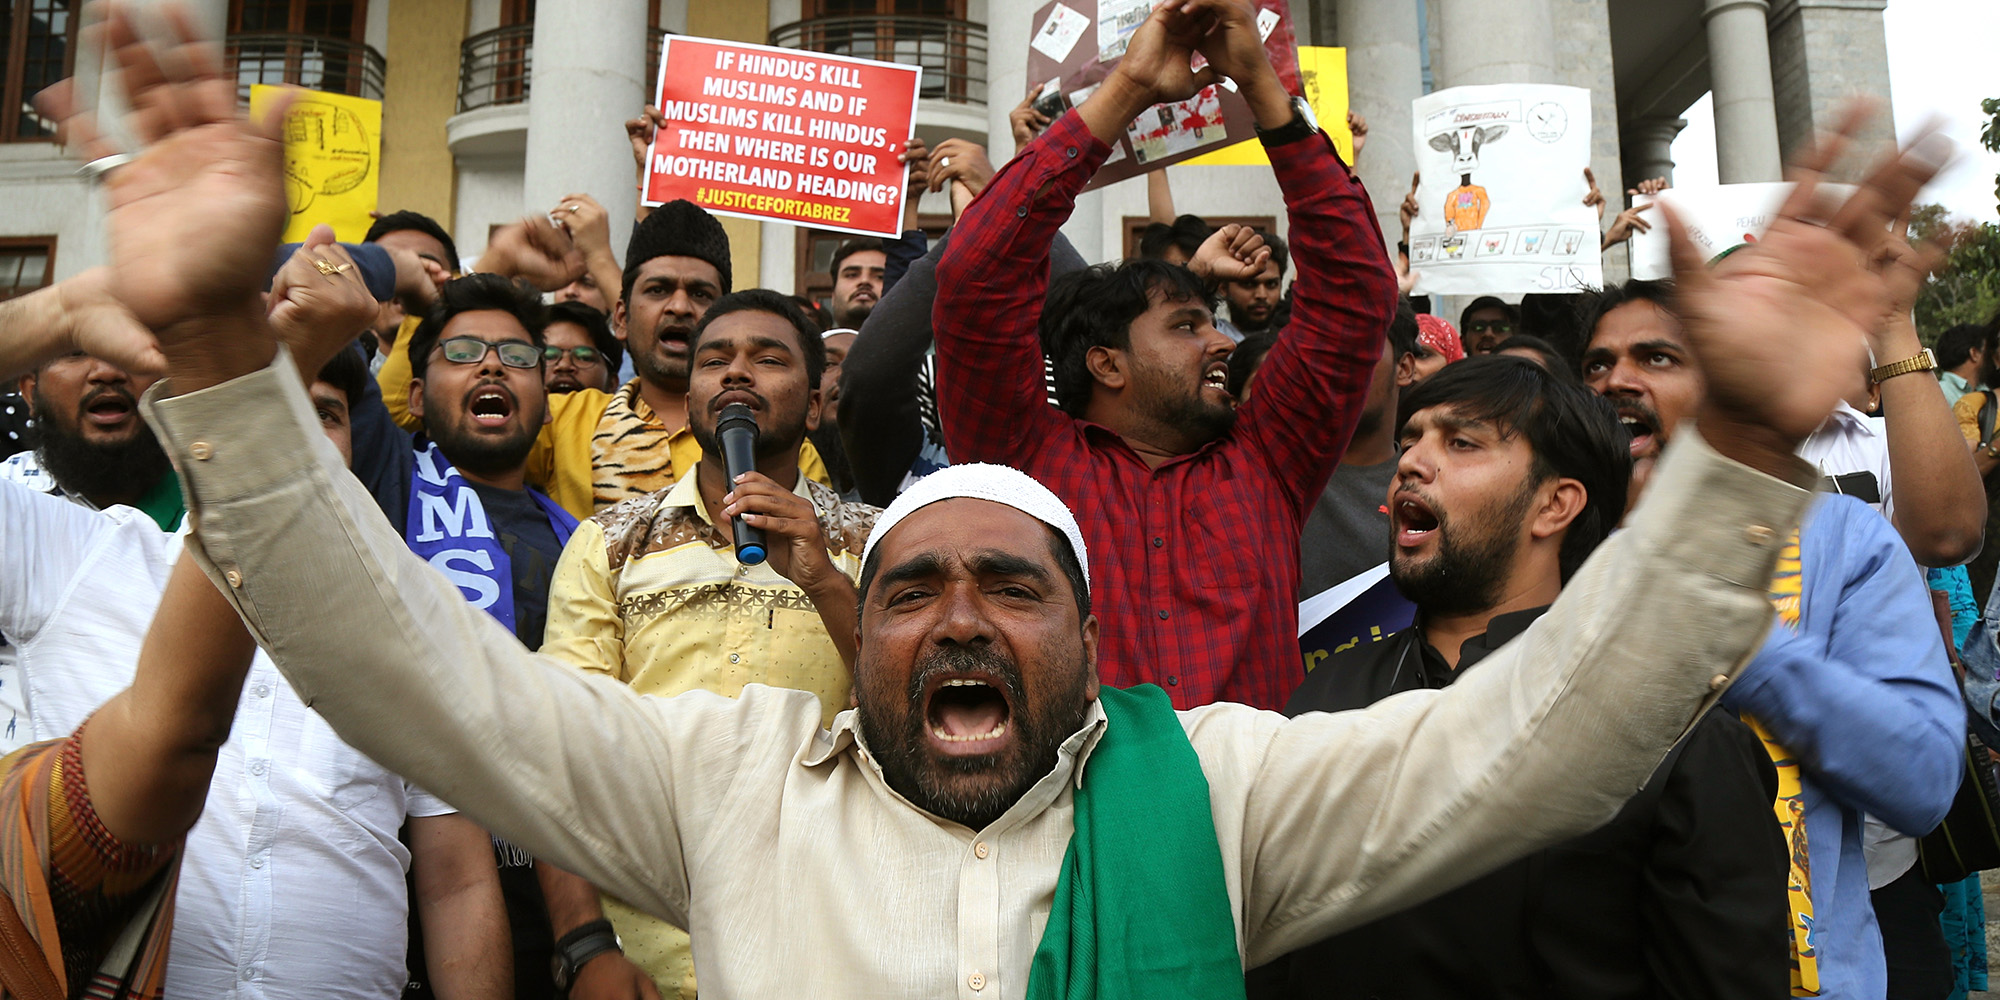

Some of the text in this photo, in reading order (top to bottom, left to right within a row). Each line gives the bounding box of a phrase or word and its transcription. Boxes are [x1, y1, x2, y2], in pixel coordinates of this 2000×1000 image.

[715, 51, 862, 89] IF HINDUS KILL
[703, 76, 867, 117] MUSLIMS AND IF
[665, 100, 758, 130] MUSLIMS
[762, 112, 804, 136] KILL
[808, 118, 887, 148] HINDUS
[679, 129, 877, 175] THEN WHERE IS OUR
[654, 154, 899, 206] MOTHERLAND HEADING?
[696, 187, 851, 223] #JUSTICEFORTABREZ
